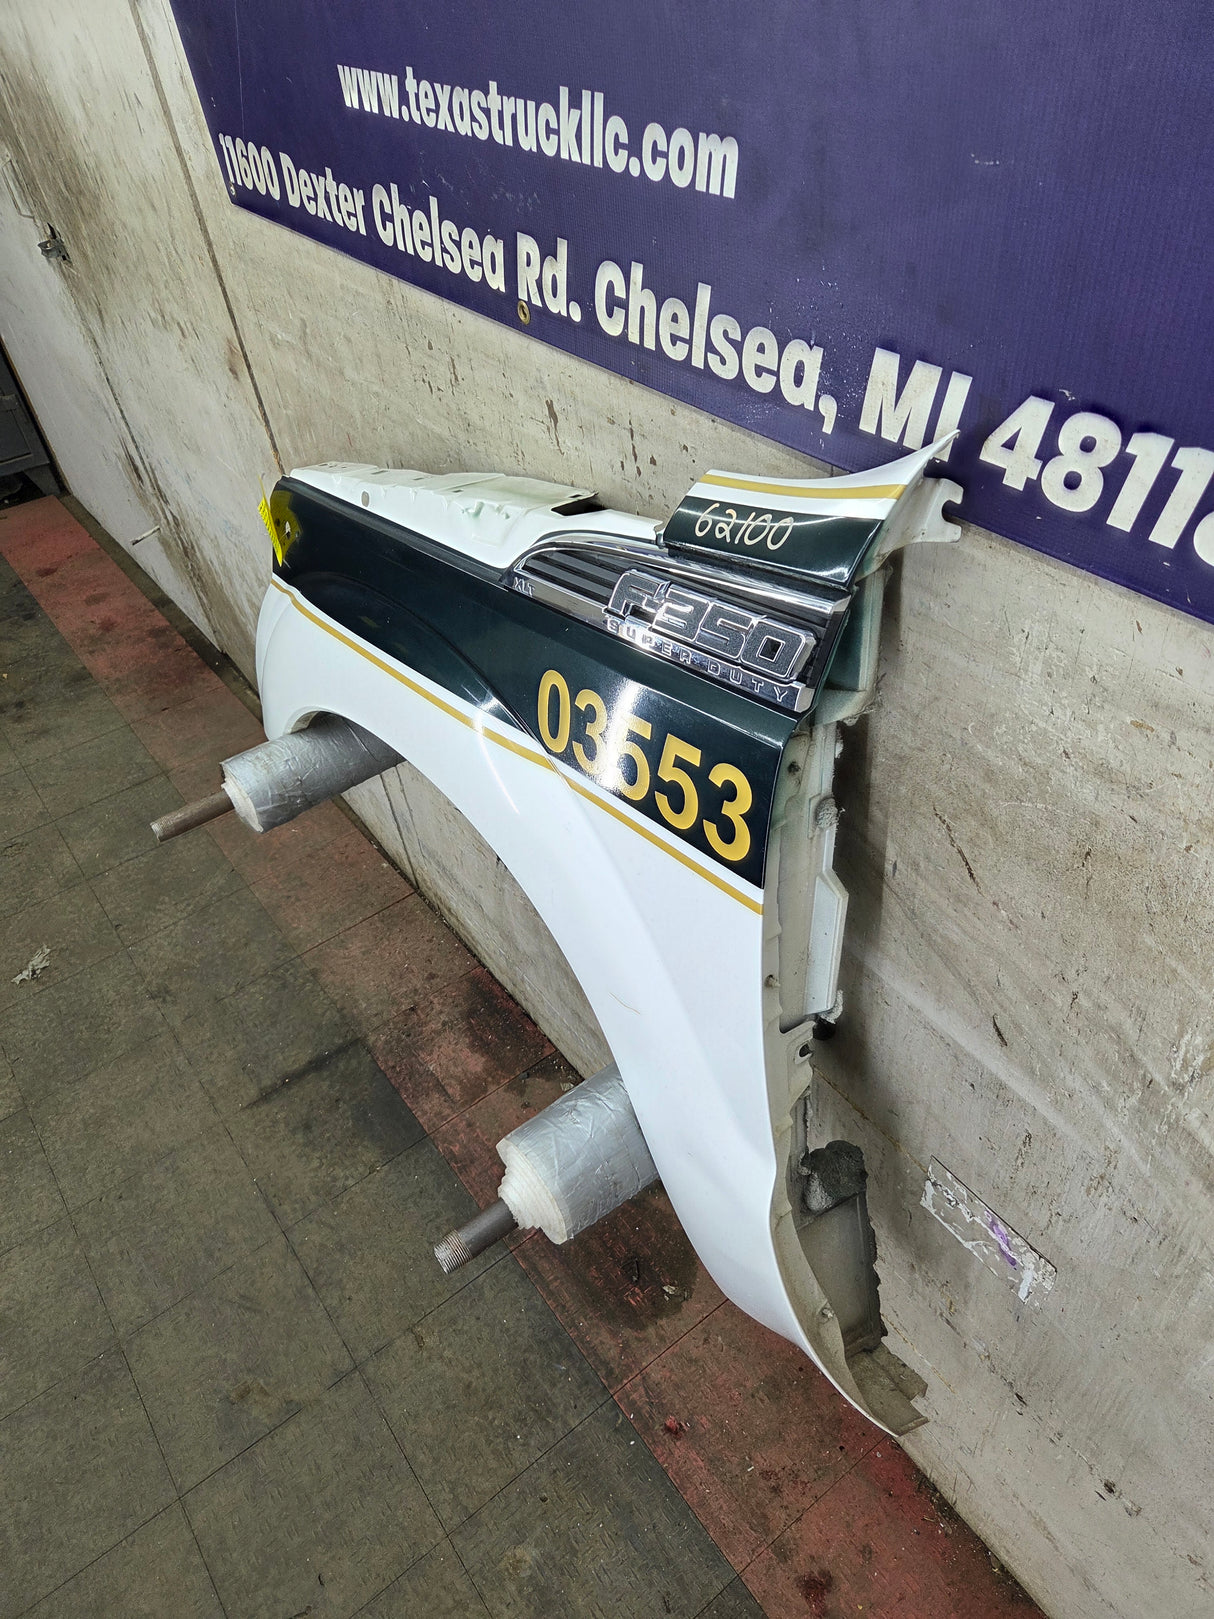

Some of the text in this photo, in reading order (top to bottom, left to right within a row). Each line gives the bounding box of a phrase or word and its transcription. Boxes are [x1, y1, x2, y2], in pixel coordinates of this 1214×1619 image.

[337, 65, 739, 199] www.texastruckllc.com
[218, 132, 1214, 570] 11600 Dexter Chelsea Rd. Chelsea, MI 4811
[694, 502, 794, 551] 62100
[513, 576, 535, 597] XLT
[606, 616, 788, 703] SUPER DUTY
[537, 669, 753, 862] 03553
